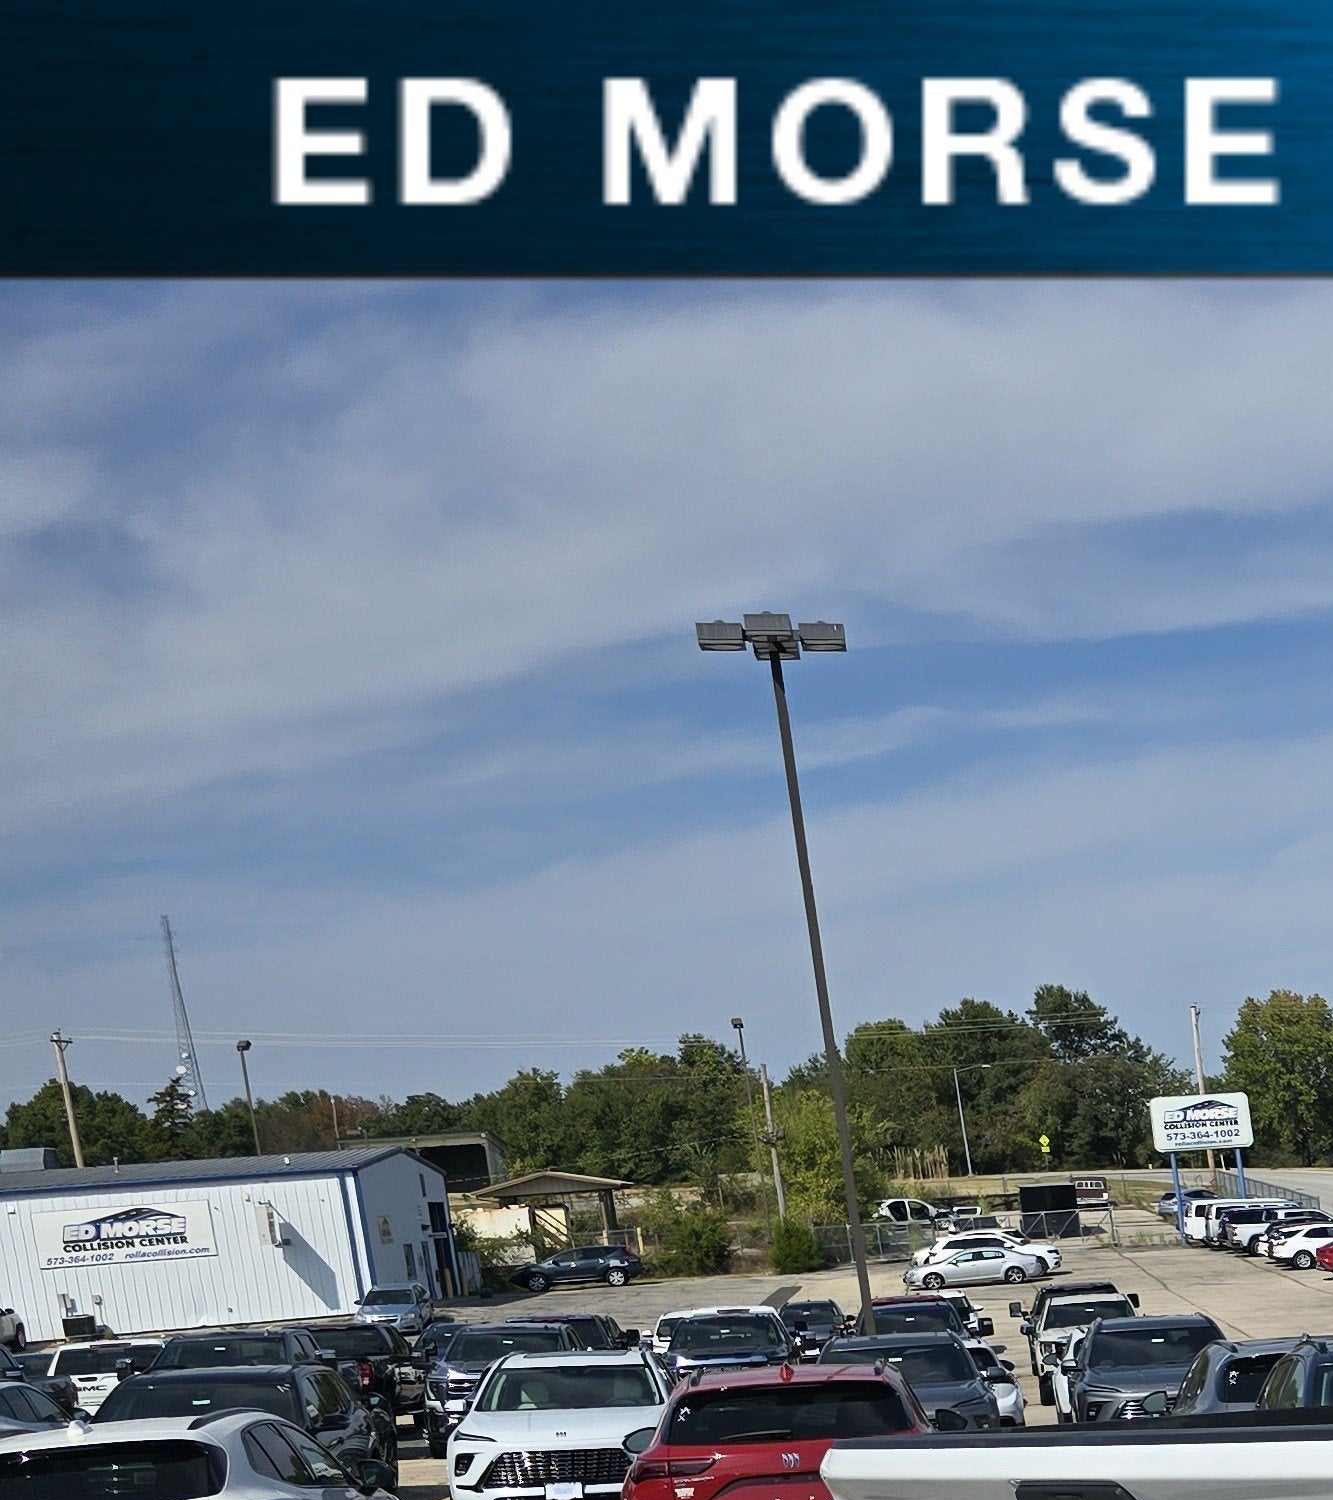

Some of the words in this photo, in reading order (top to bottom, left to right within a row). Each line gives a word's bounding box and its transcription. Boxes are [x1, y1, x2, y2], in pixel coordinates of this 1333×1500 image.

[1165, 1110, 1185, 1122] ED
[1186, 1106, 1238, 1121] MORSE
[1164, 1121, 1207, 1130] COLLISION
[1210, 1119, 1239, 1127] CENTER
[1166, 1129, 1240, 1141] 573-364-1002
[63, 1223, 97, 1242] ED
[101, 1216, 186, 1240] MORSE
[63, 1239, 135, 1253] COLLISION
[139, 1235, 189, 1247] CENTER
[46, 1253, 115, 1266] 573-364-1002
[125, 1247, 211, 1259] rollacollision.com
